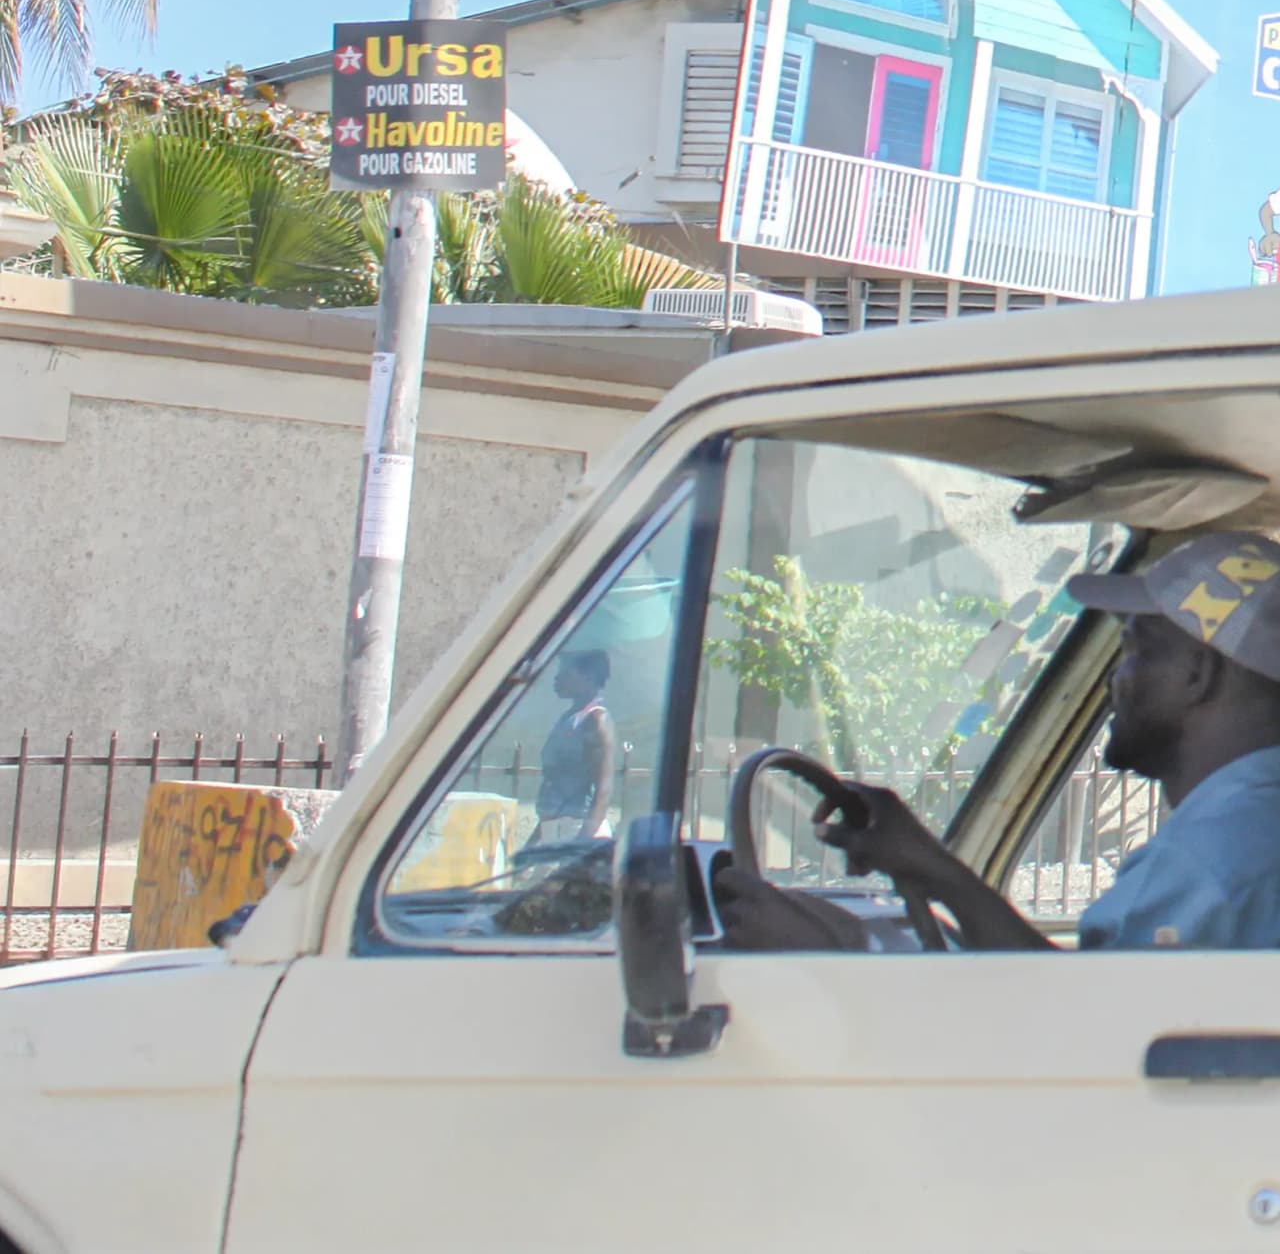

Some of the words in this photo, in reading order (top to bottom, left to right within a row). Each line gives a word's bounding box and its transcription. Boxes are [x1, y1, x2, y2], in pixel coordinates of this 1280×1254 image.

[366, 34, 503, 79] Ursa
[366, 83, 409, 107] POUR
[412, 83, 468, 106] DIESEL
[366, 111, 504, 149] Havoline
[359, 153, 400, 176] POUR
[403, 152, 477, 175] GAZOLINE
